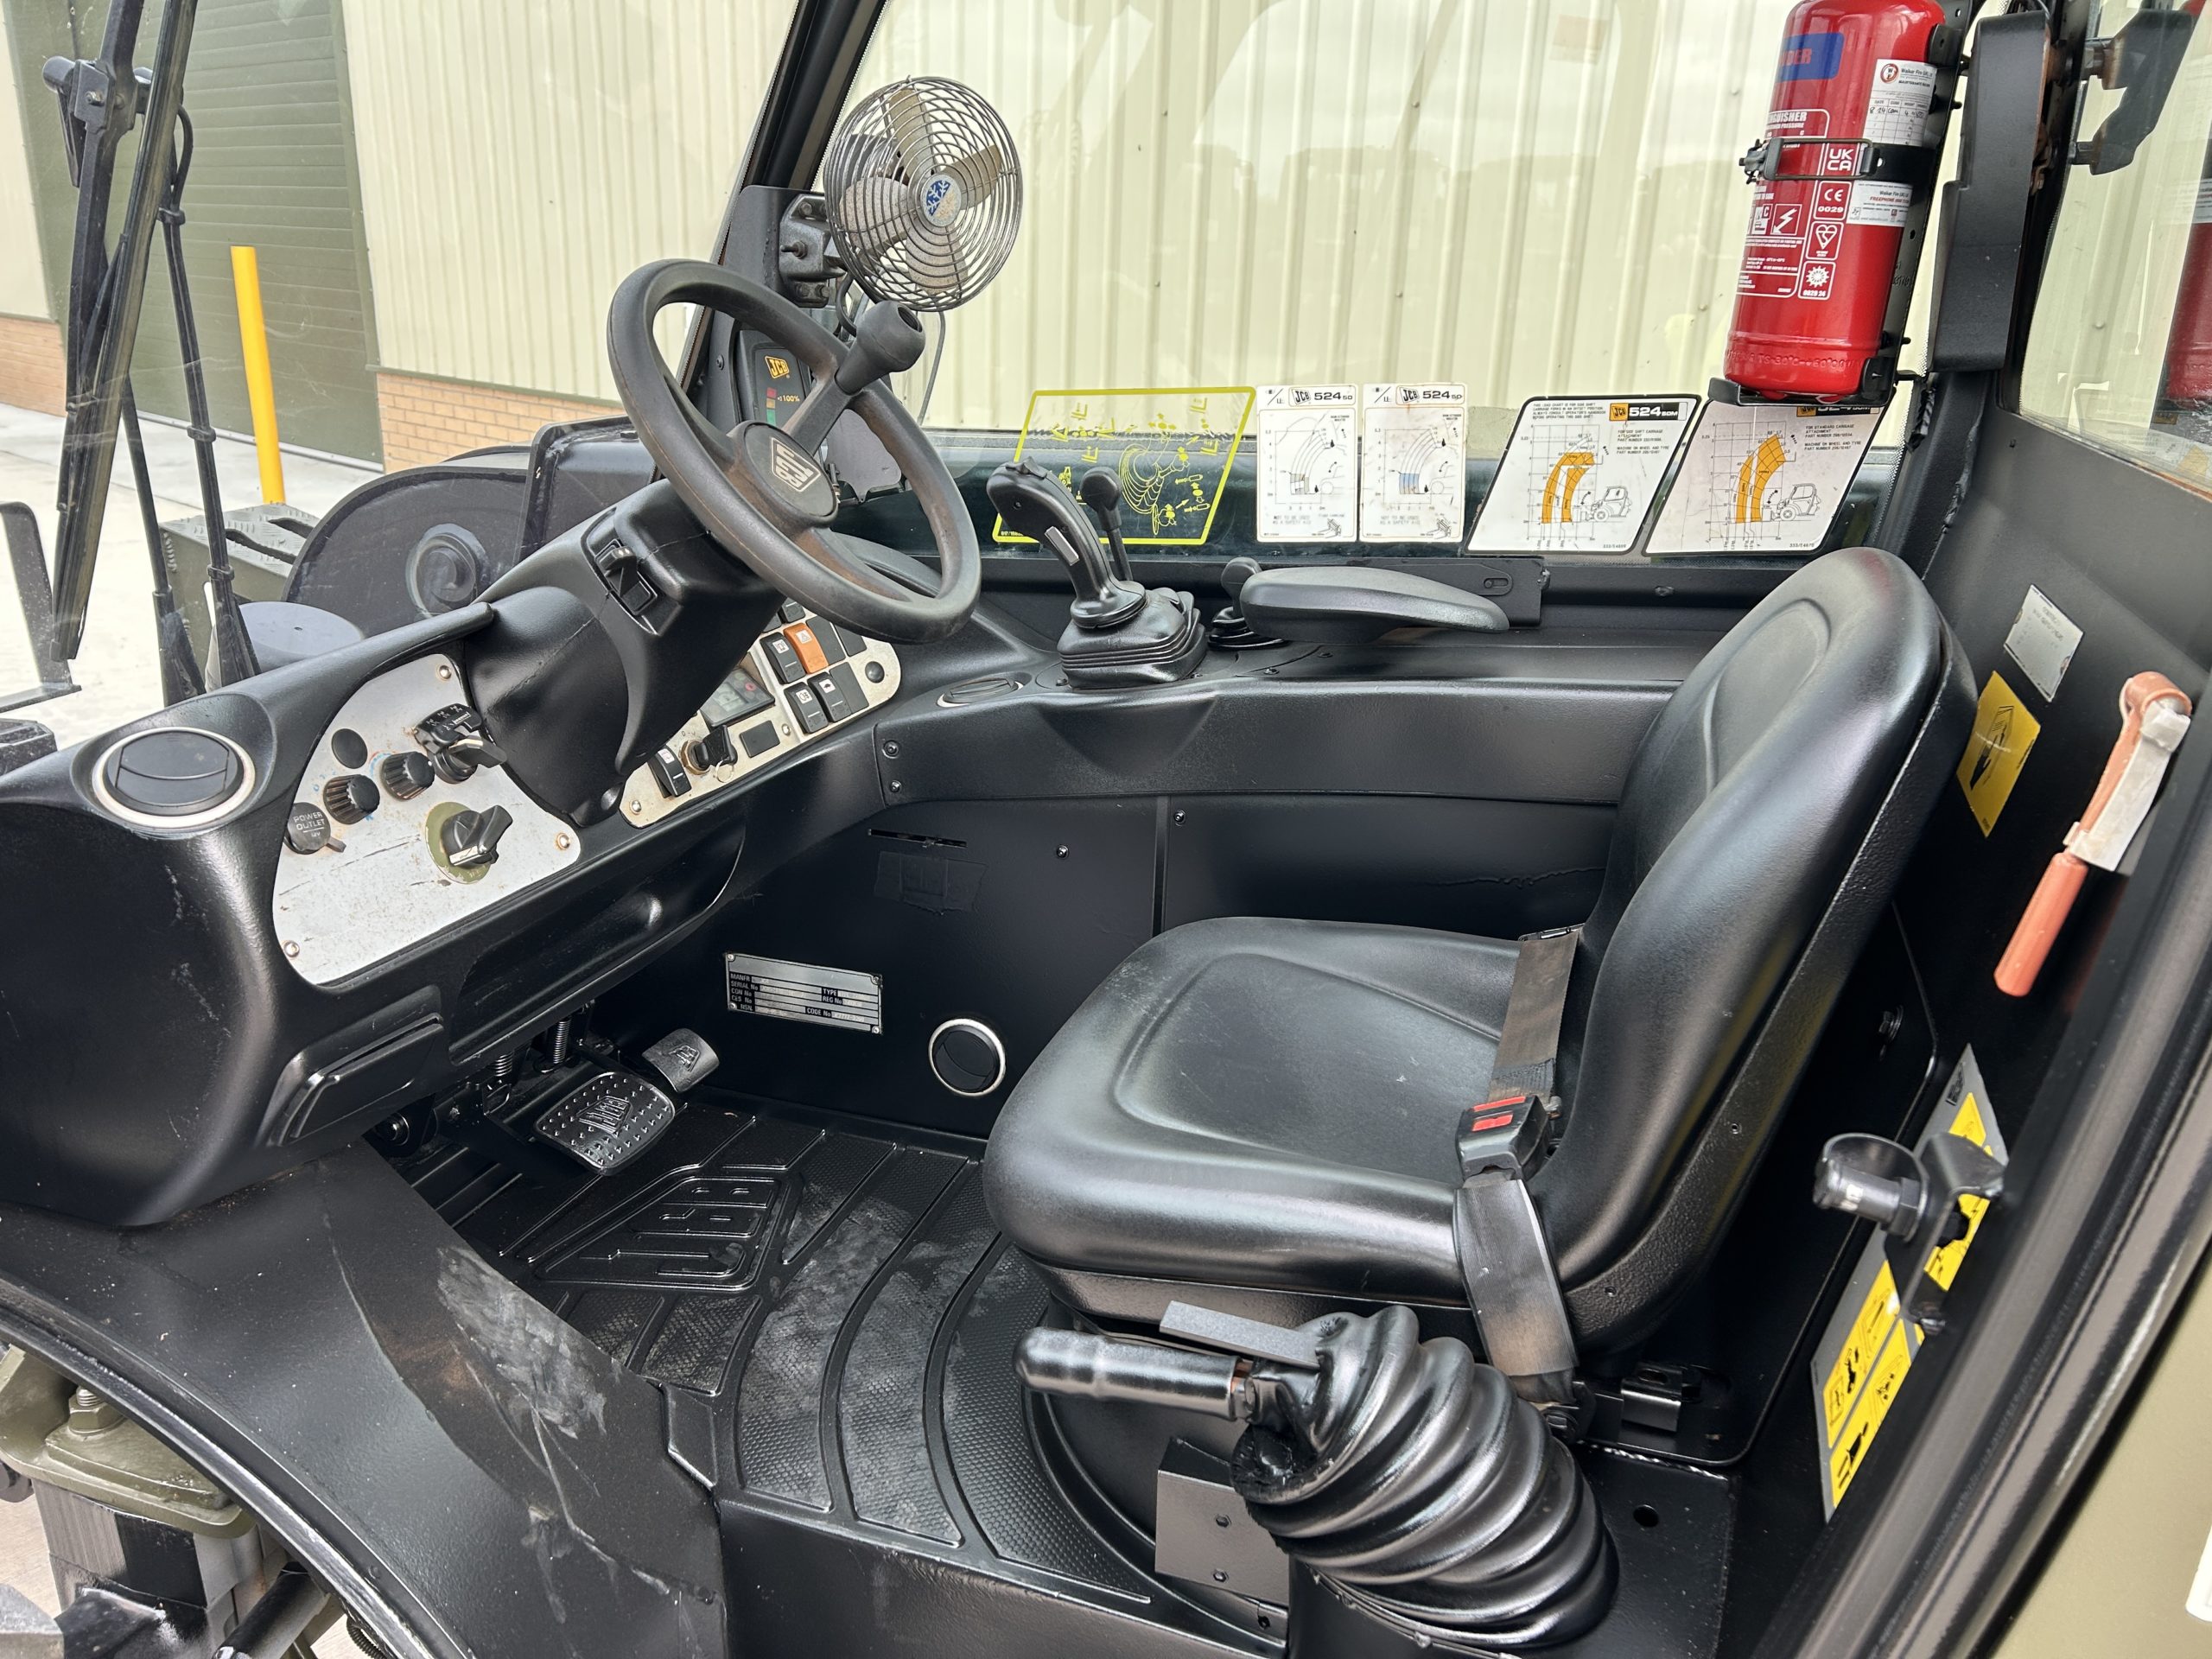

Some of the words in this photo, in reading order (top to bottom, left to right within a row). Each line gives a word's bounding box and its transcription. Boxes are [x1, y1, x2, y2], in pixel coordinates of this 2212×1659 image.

[1829, 148, 1854, 160] UK
[1827, 160, 1852, 171] CA
[1824, 188, 1843, 201] CE
[768, 359, 788, 377] JCB
[1295, 390, 1309, 403] JCB
[1314, 391, 1341, 401] 524
[1402, 389, 1418, 402] JCB
[1422, 391, 1450, 399] 524
[1629, 406, 1661, 416] 524
[774, 442, 816, 489] JCB
[293, 811, 323, 823] POWER
[296, 818, 326, 830] OUTLET
[730, 980, 749, 989] SERIAL
[823, 988, 837, 996] TYPE
[806, 1007, 822, 1015] CODE
